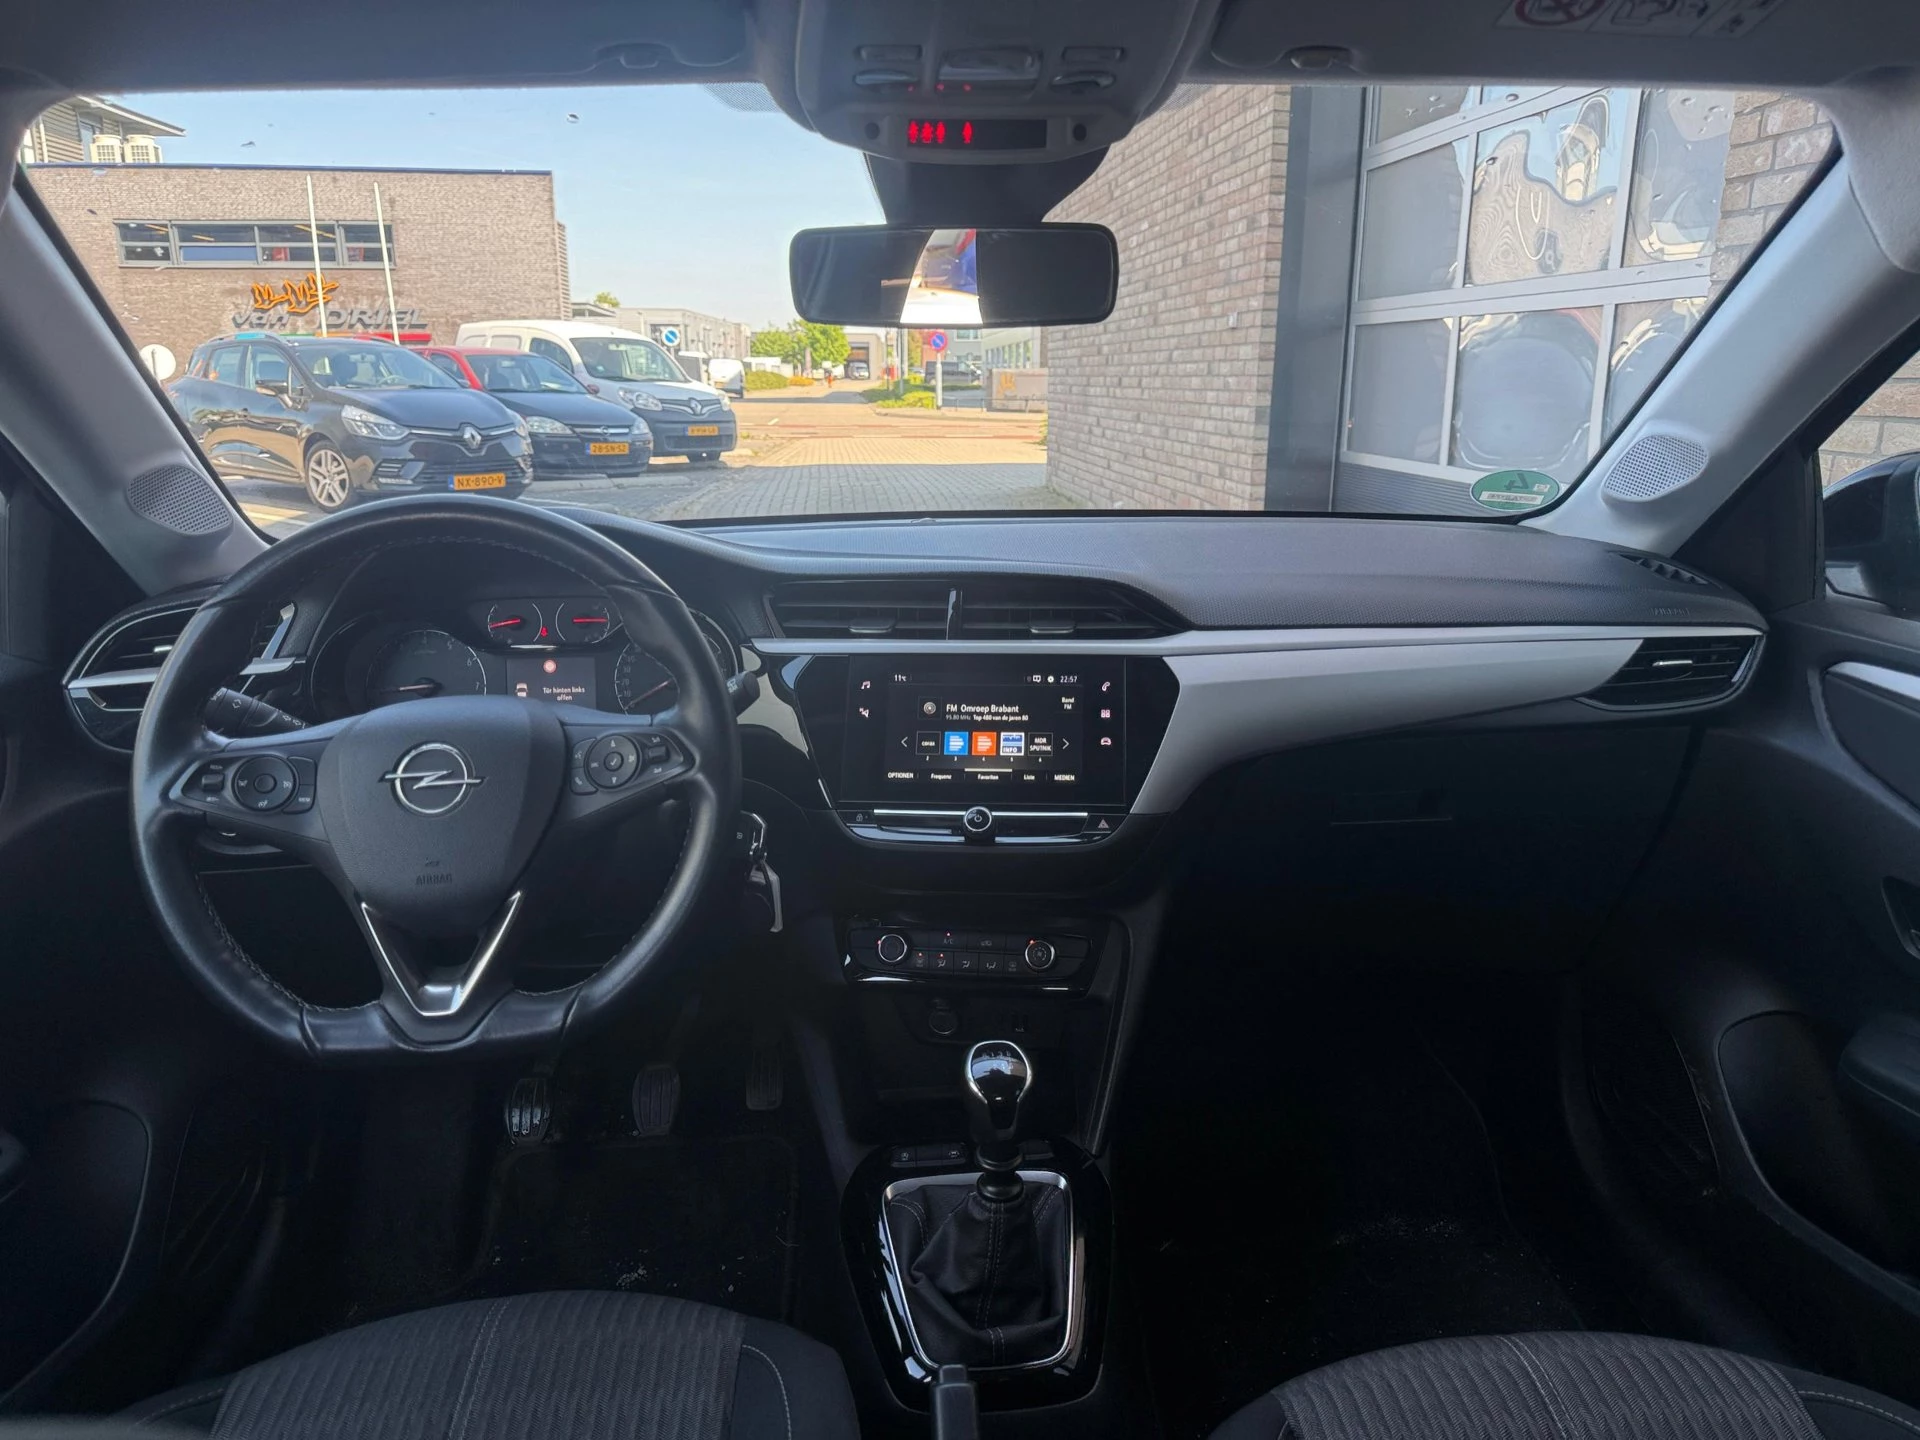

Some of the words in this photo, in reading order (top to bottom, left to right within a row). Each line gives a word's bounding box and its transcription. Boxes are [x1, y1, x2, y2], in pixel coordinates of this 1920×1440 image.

[232, 310, 291, 330] van
[457, 475, 503, 489] NX-890-V
[1060, 675, 1078, 683] 22:57
[556, 693, 573, 701] offen
[946, 703, 958, 713] FM
[960, 703, 990, 715] Omroep
[990, 703, 1019, 713] Brabant
[1054, 773, 1075, 781] MEDIEN
